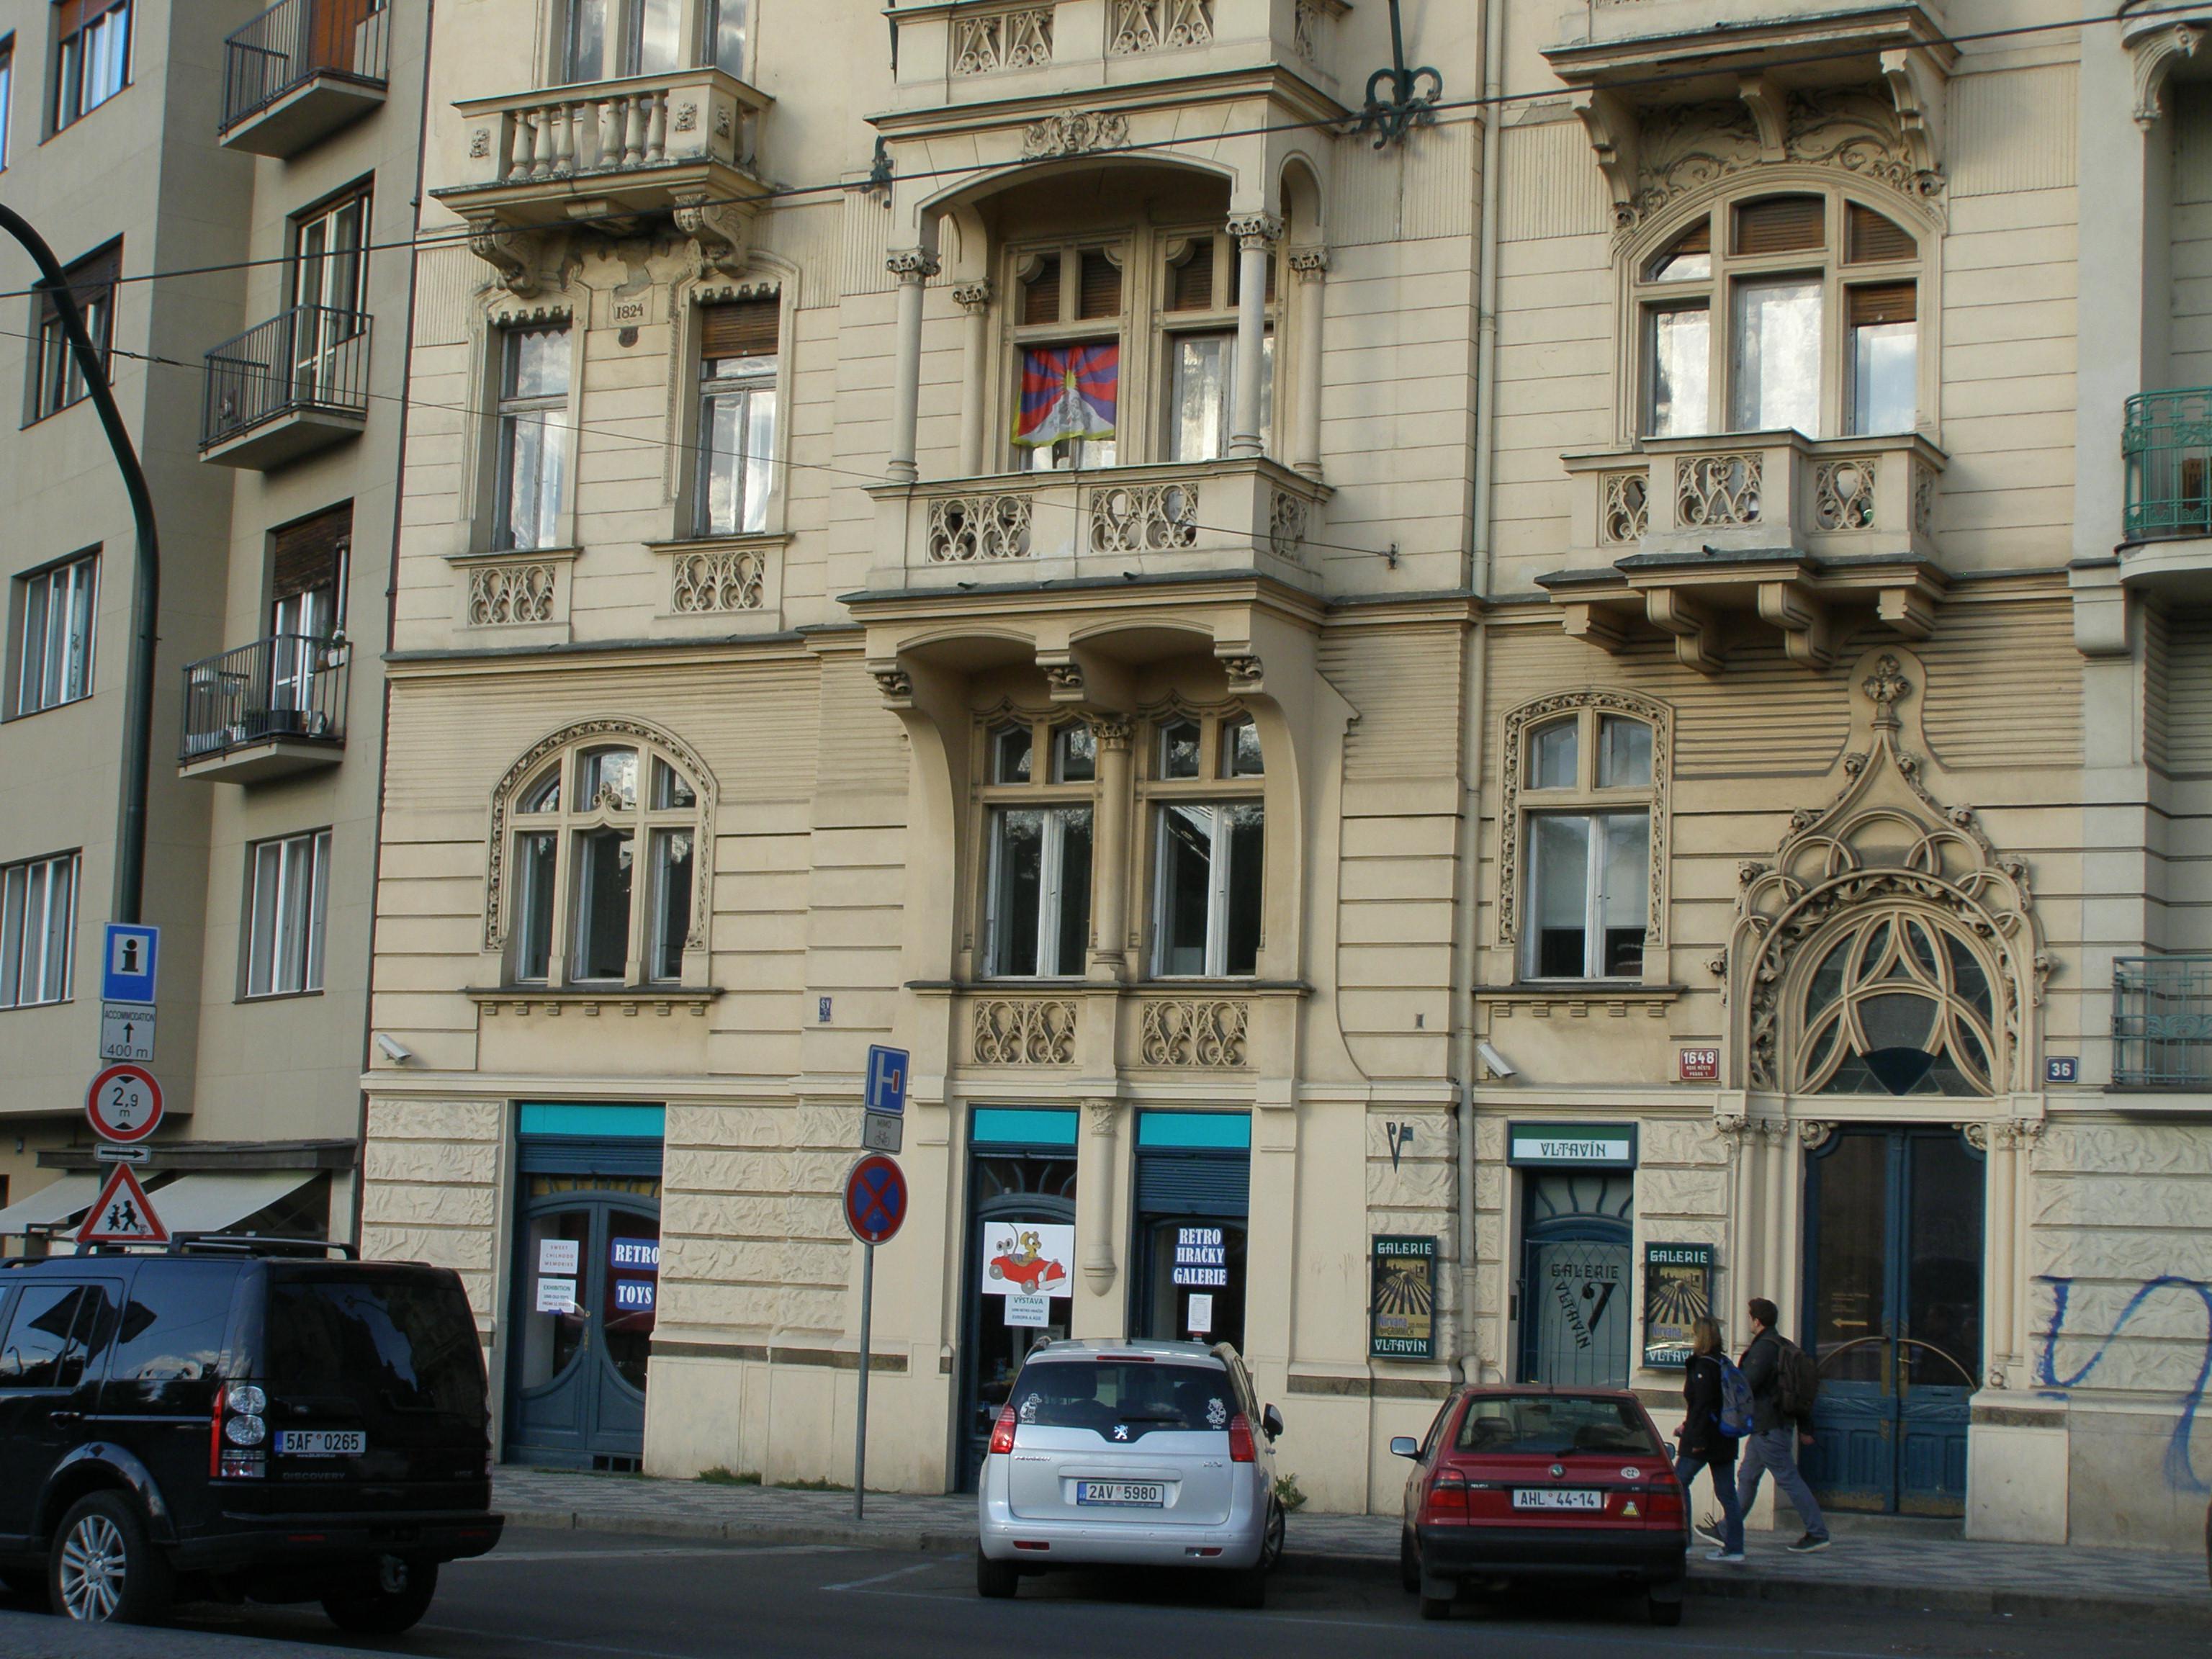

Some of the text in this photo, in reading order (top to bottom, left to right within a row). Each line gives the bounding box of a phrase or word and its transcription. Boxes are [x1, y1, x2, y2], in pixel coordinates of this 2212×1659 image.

[616, 303, 644, 320] 1824
[104, 1010, 156, 1022] ACCOMMODATION
[107, 1044, 148, 1058] 400 m
[1683, 1051, 1714, 1064] 1648
[2051, 1062, 2072, 1076] 36
[112, 1087, 139, 1107] 2,9
[1540, 1141, 1606, 1157] VLTAVÍN
[1179, 1228, 1221, 1245] RETRO
[615, 1244, 660, 1264] RETRO
[1176, 1245, 1225, 1264] HRAČKY
[1377, 1243, 1432, 1254] GALERIE
[1650, 1250, 1708, 1263] GALERIE
[1174, 1268, 1226, 1285] GALERIE
[1551, 1264, 1619, 1279] GALERIE
[618, 1285, 652, 1305] TOYS
[1013, 1295, 1043, 1305] VÝSTAVA
[1379, 1315, 1407, 1326] Nirvana
[1653, 1326, 1682, 1337] Nirvana
[1375, 1338, 1427, 1352] VLTAVÍN
[1649, 1350, 1694, 1362] VLTAV
[287, 1434, 313, 1450] 5AF
[324, 1434, 359, 1451] 0265
[283, 1472, 346, 1480] DISCOVERY
[1089, 1485, 1114, 1499] 2AV
[1124, 1486, 1157, 1500] 5980
[1520, 1491, 1595, 1506] AHL 44-14
